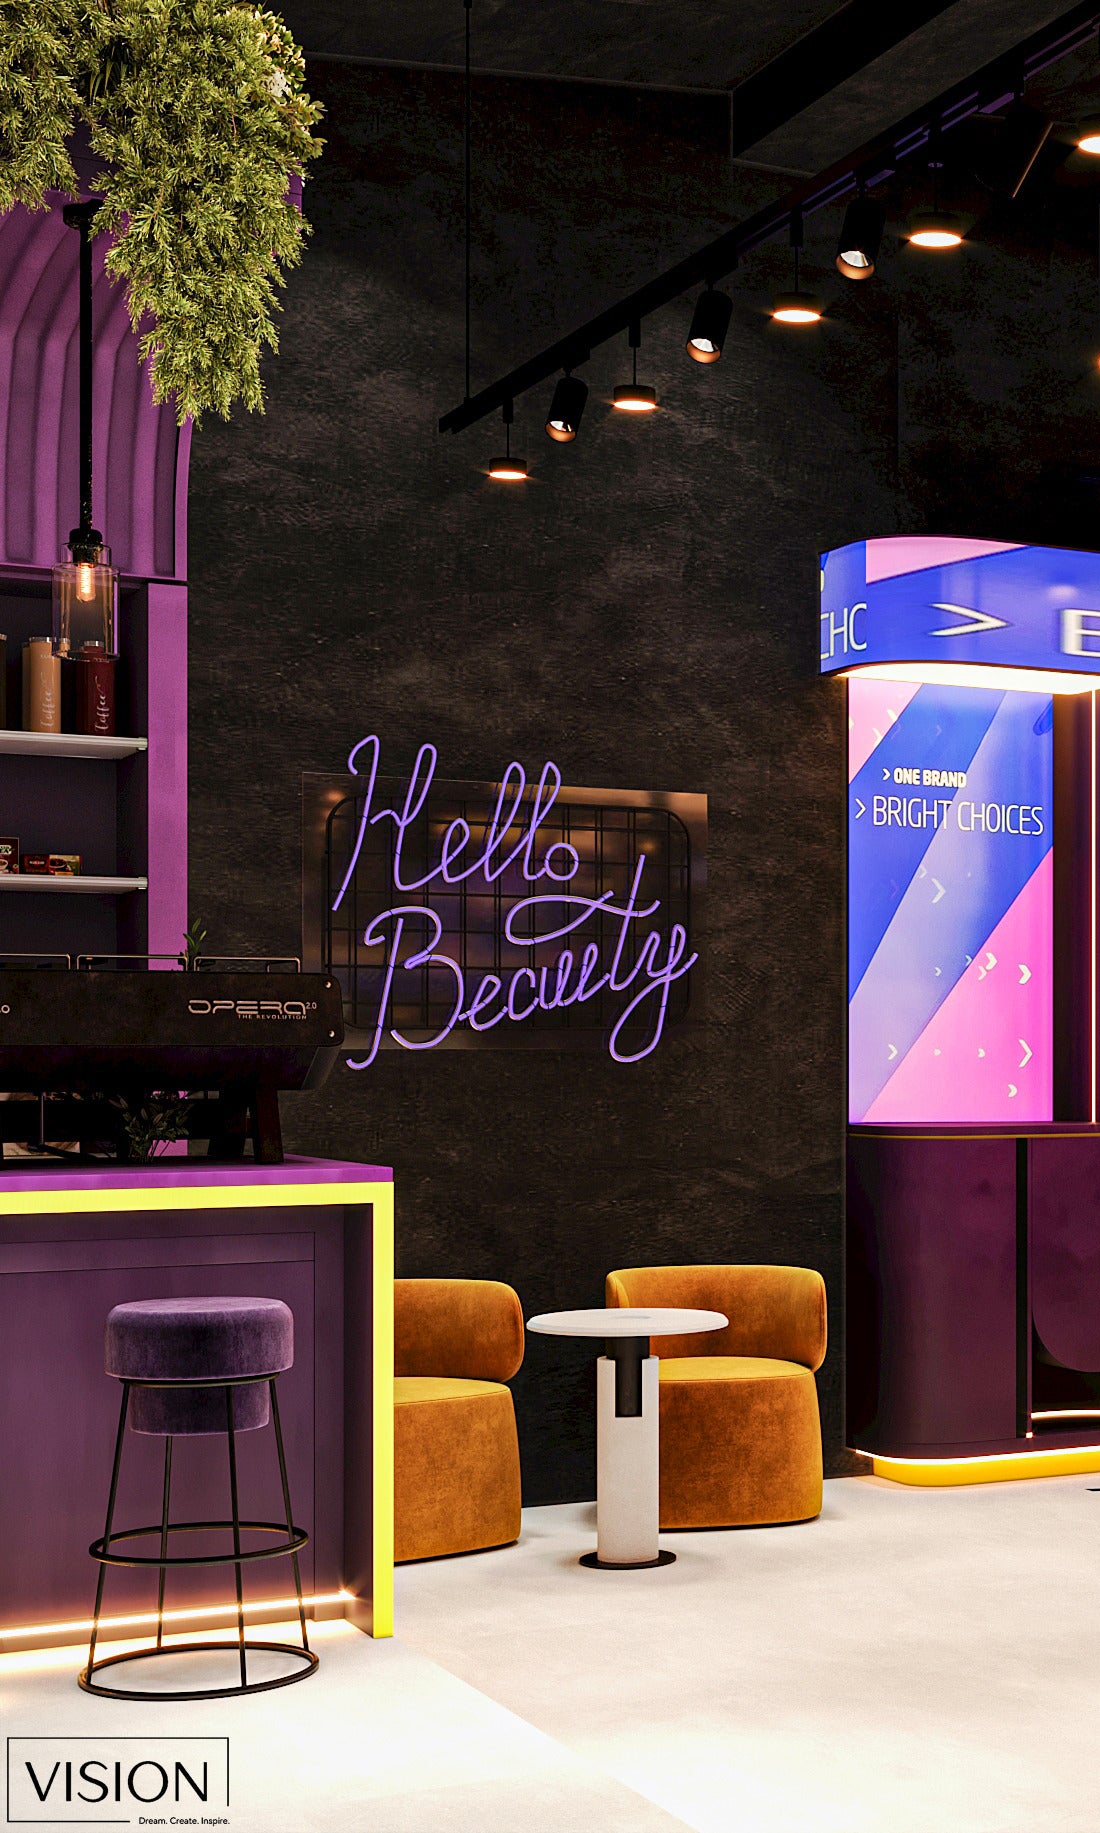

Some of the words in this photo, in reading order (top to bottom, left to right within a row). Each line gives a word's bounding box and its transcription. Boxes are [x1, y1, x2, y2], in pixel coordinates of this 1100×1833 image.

[893, 767, 921, 785] ONE
[922, 769, 967, 788] BRAND
[332, 735, 580, 911] Hello
[873, 795, 953, 830] BRIGHT
[957, 802, 1044, 836] CHOICES
[346, 853, 699, 1070] Beauty
[188, 999, 306, 1015] OPERA
[305, 1002, 317, 1010] 2.0
